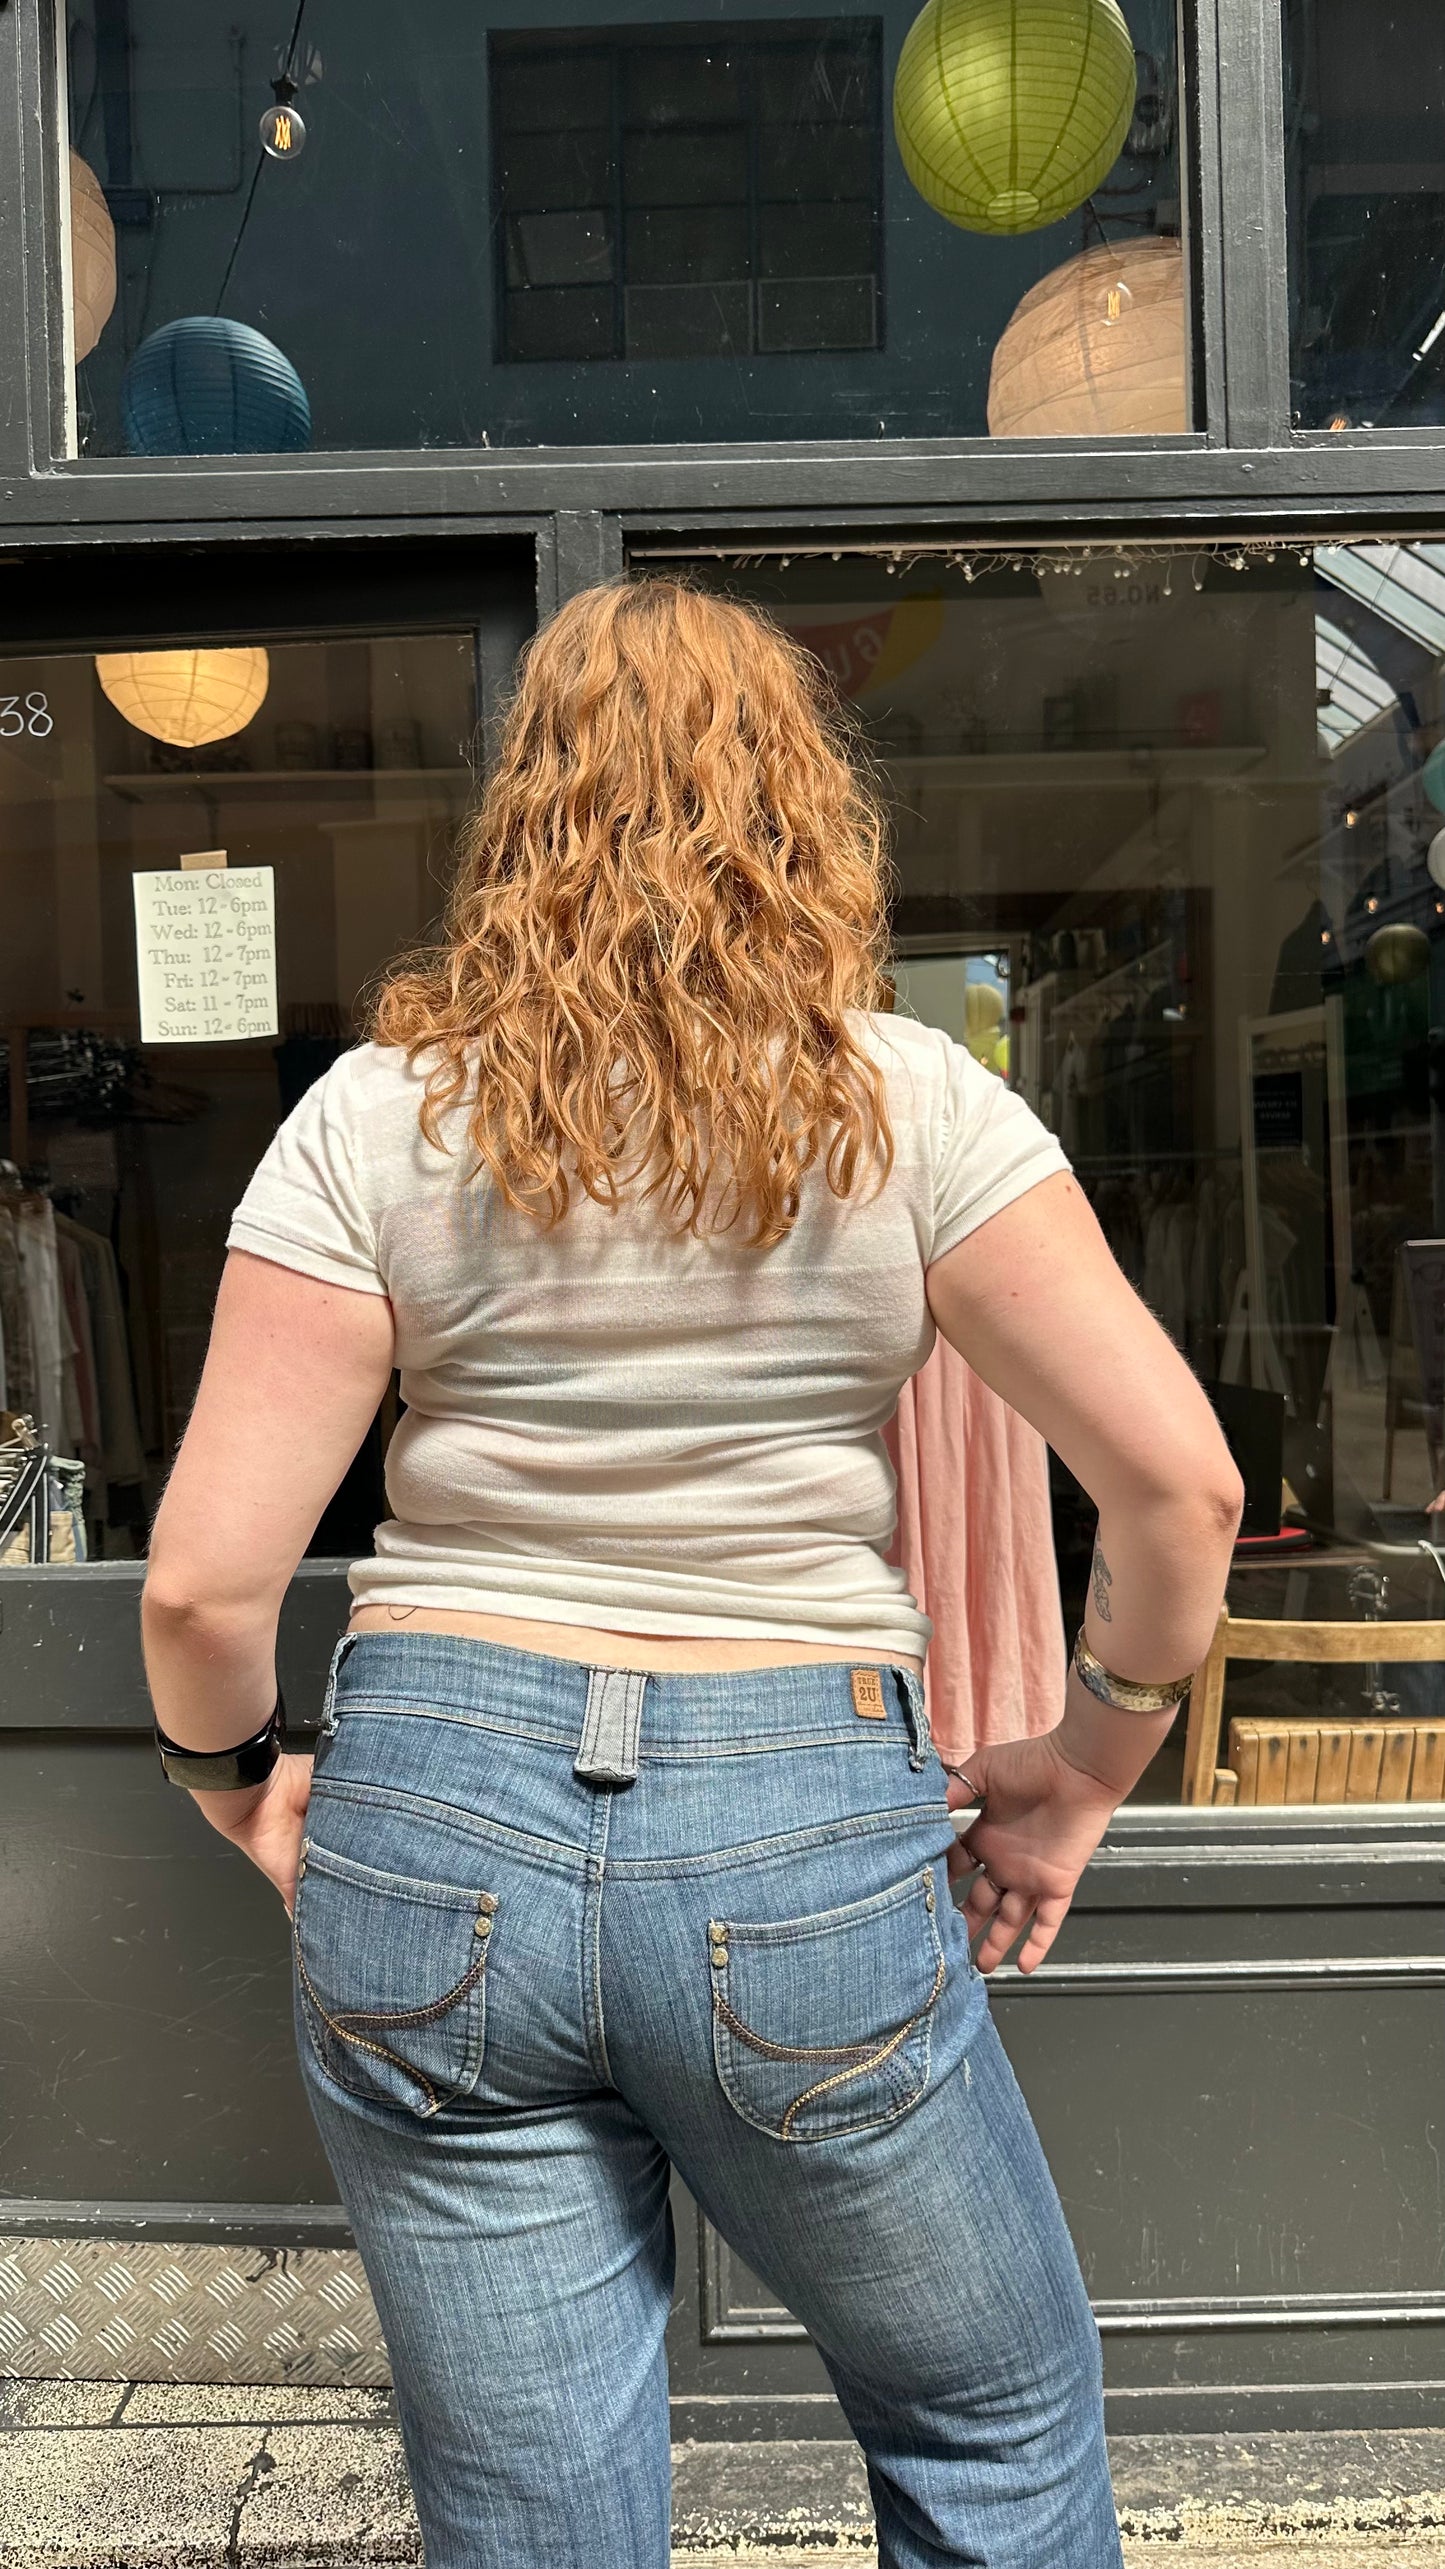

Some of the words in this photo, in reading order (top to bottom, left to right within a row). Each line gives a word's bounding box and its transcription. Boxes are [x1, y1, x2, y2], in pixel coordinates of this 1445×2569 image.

[155, 876, 199, 892] Mon:
[206, 872, 262, 889] Closed
[153, 901, 192, 916] Tue:
[151, 924, 198, 940] Wed:
[149, 949, 191, 965] Thu:
[164, 973, 193, 988] Fri:
[165, 997, 196, 1012] Sat:
[159, 1021, 197, 1036] Sun:
